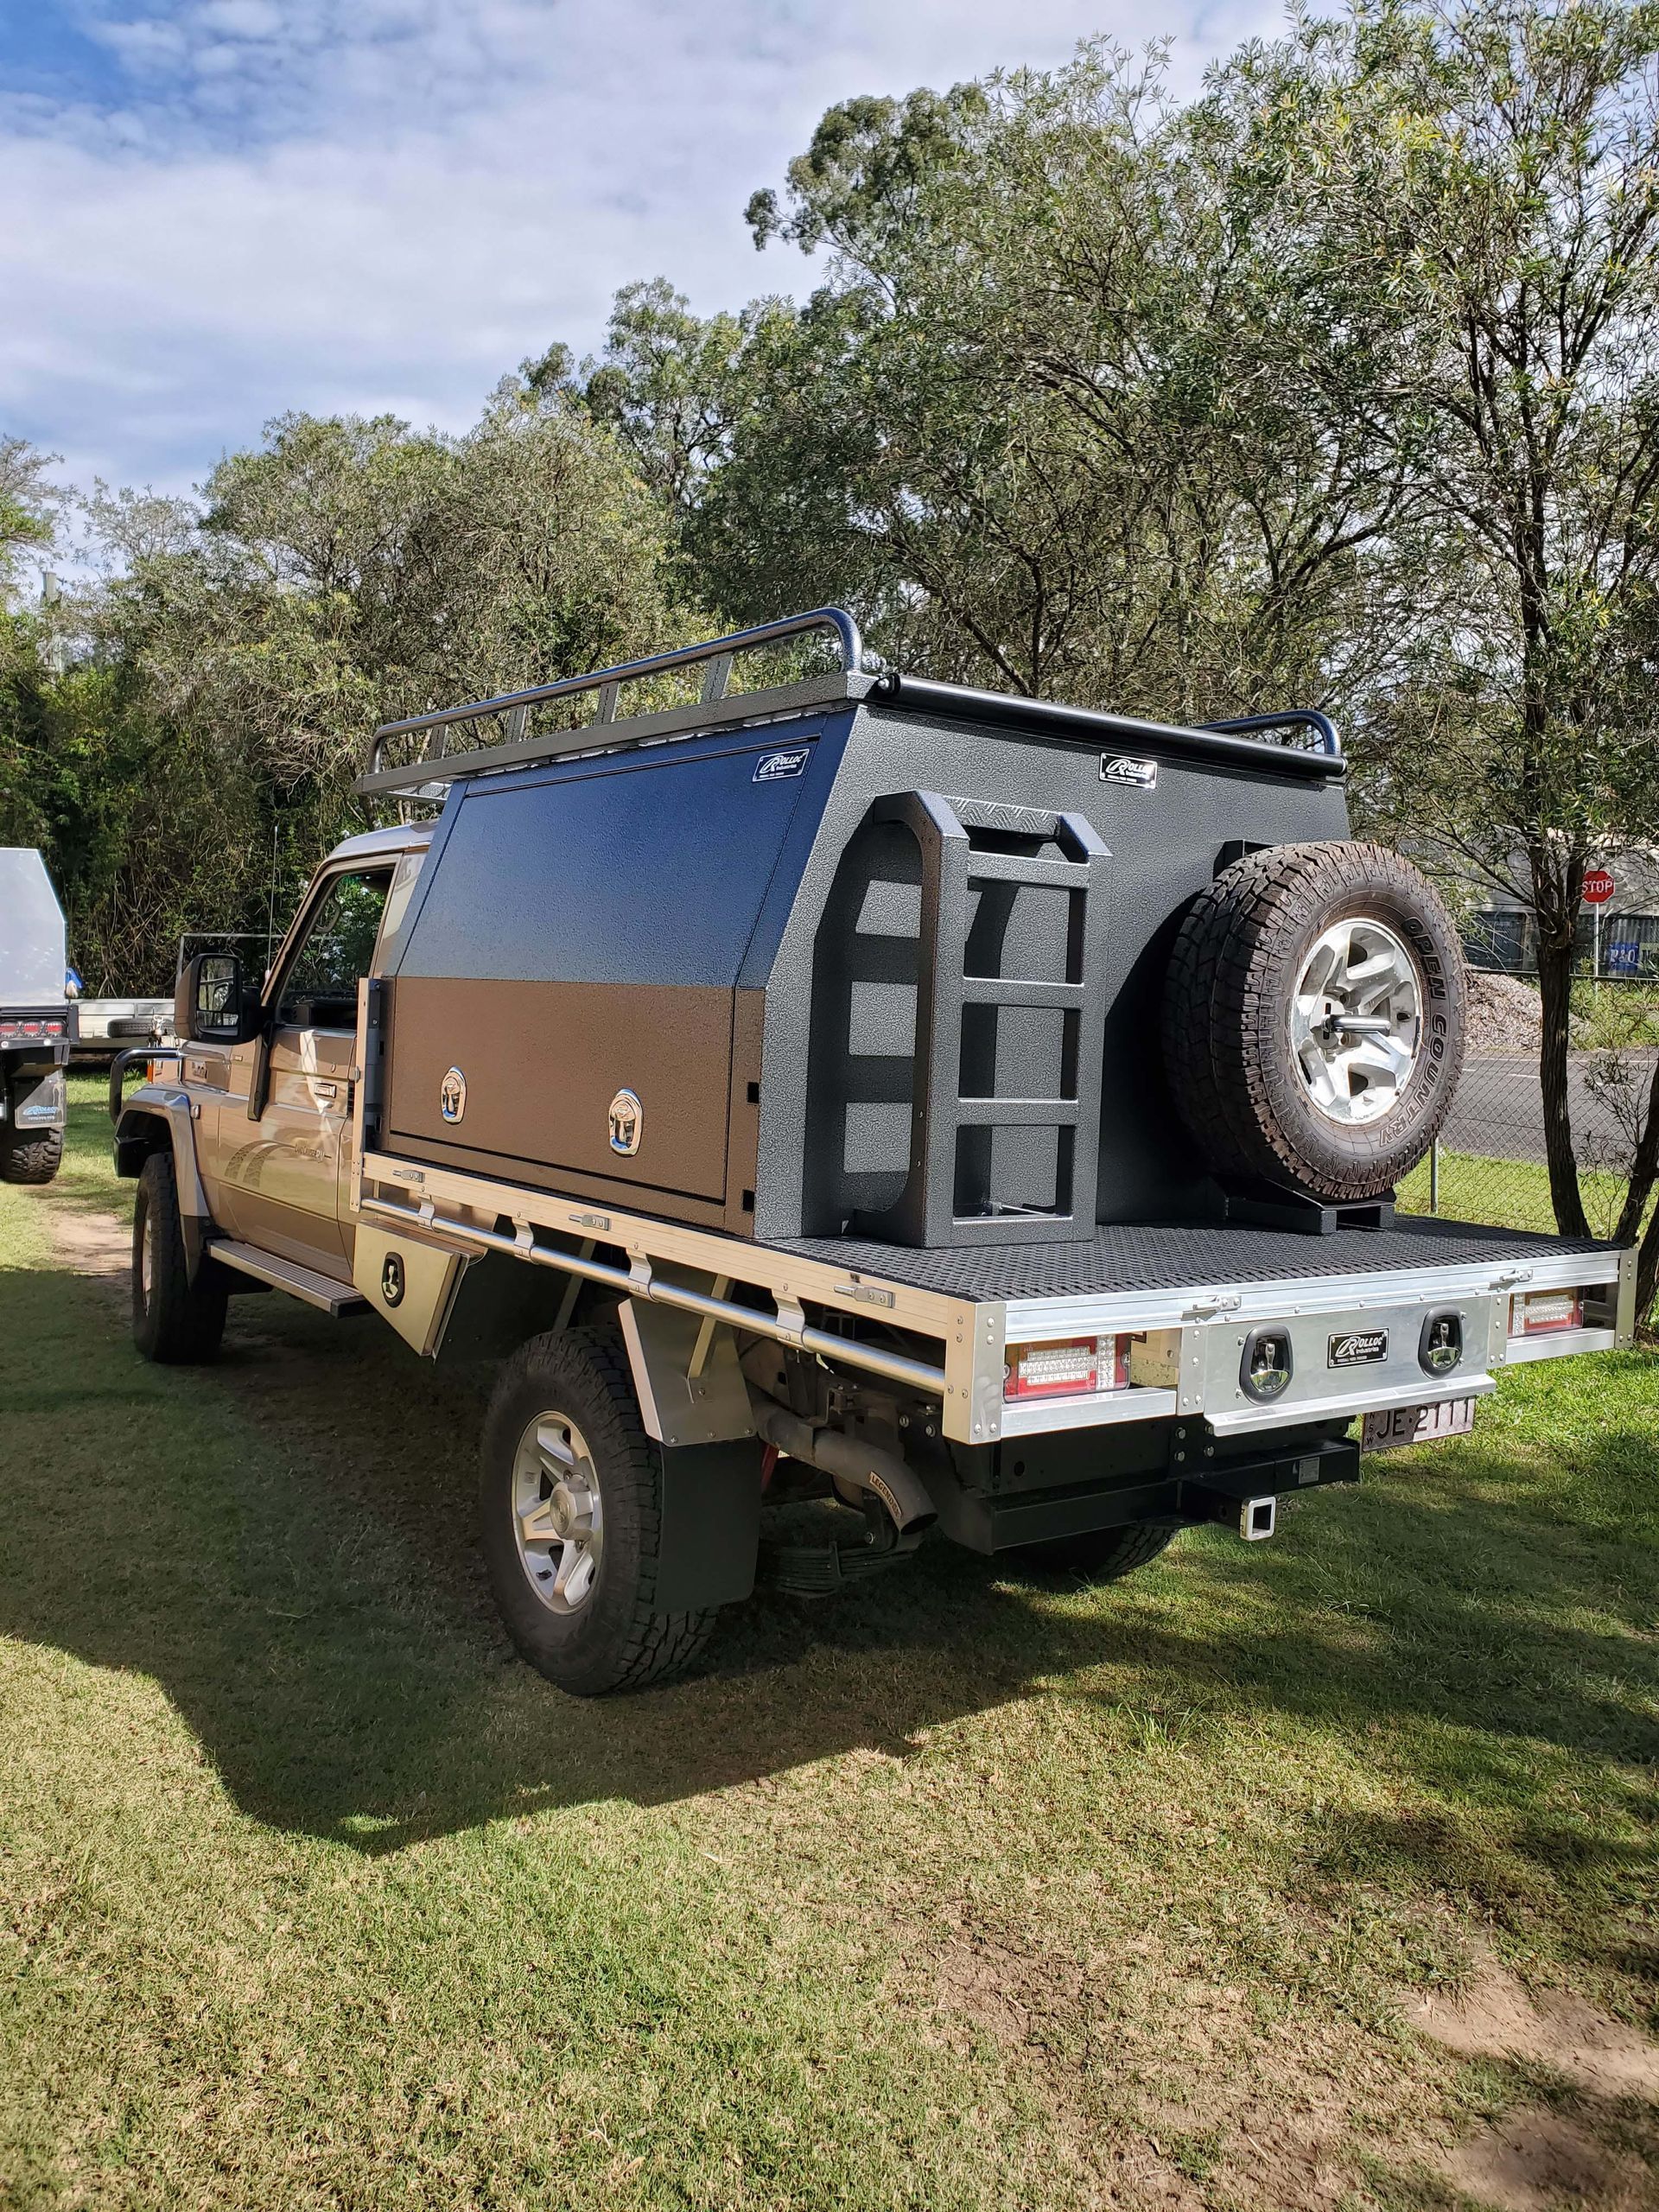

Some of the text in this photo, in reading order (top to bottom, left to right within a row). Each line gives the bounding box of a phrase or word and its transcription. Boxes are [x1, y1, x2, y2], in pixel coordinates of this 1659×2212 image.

[1581, 879, 1613, 893] STOP
[1380, 916, 1447, 1147] OPEN COUNTRY
